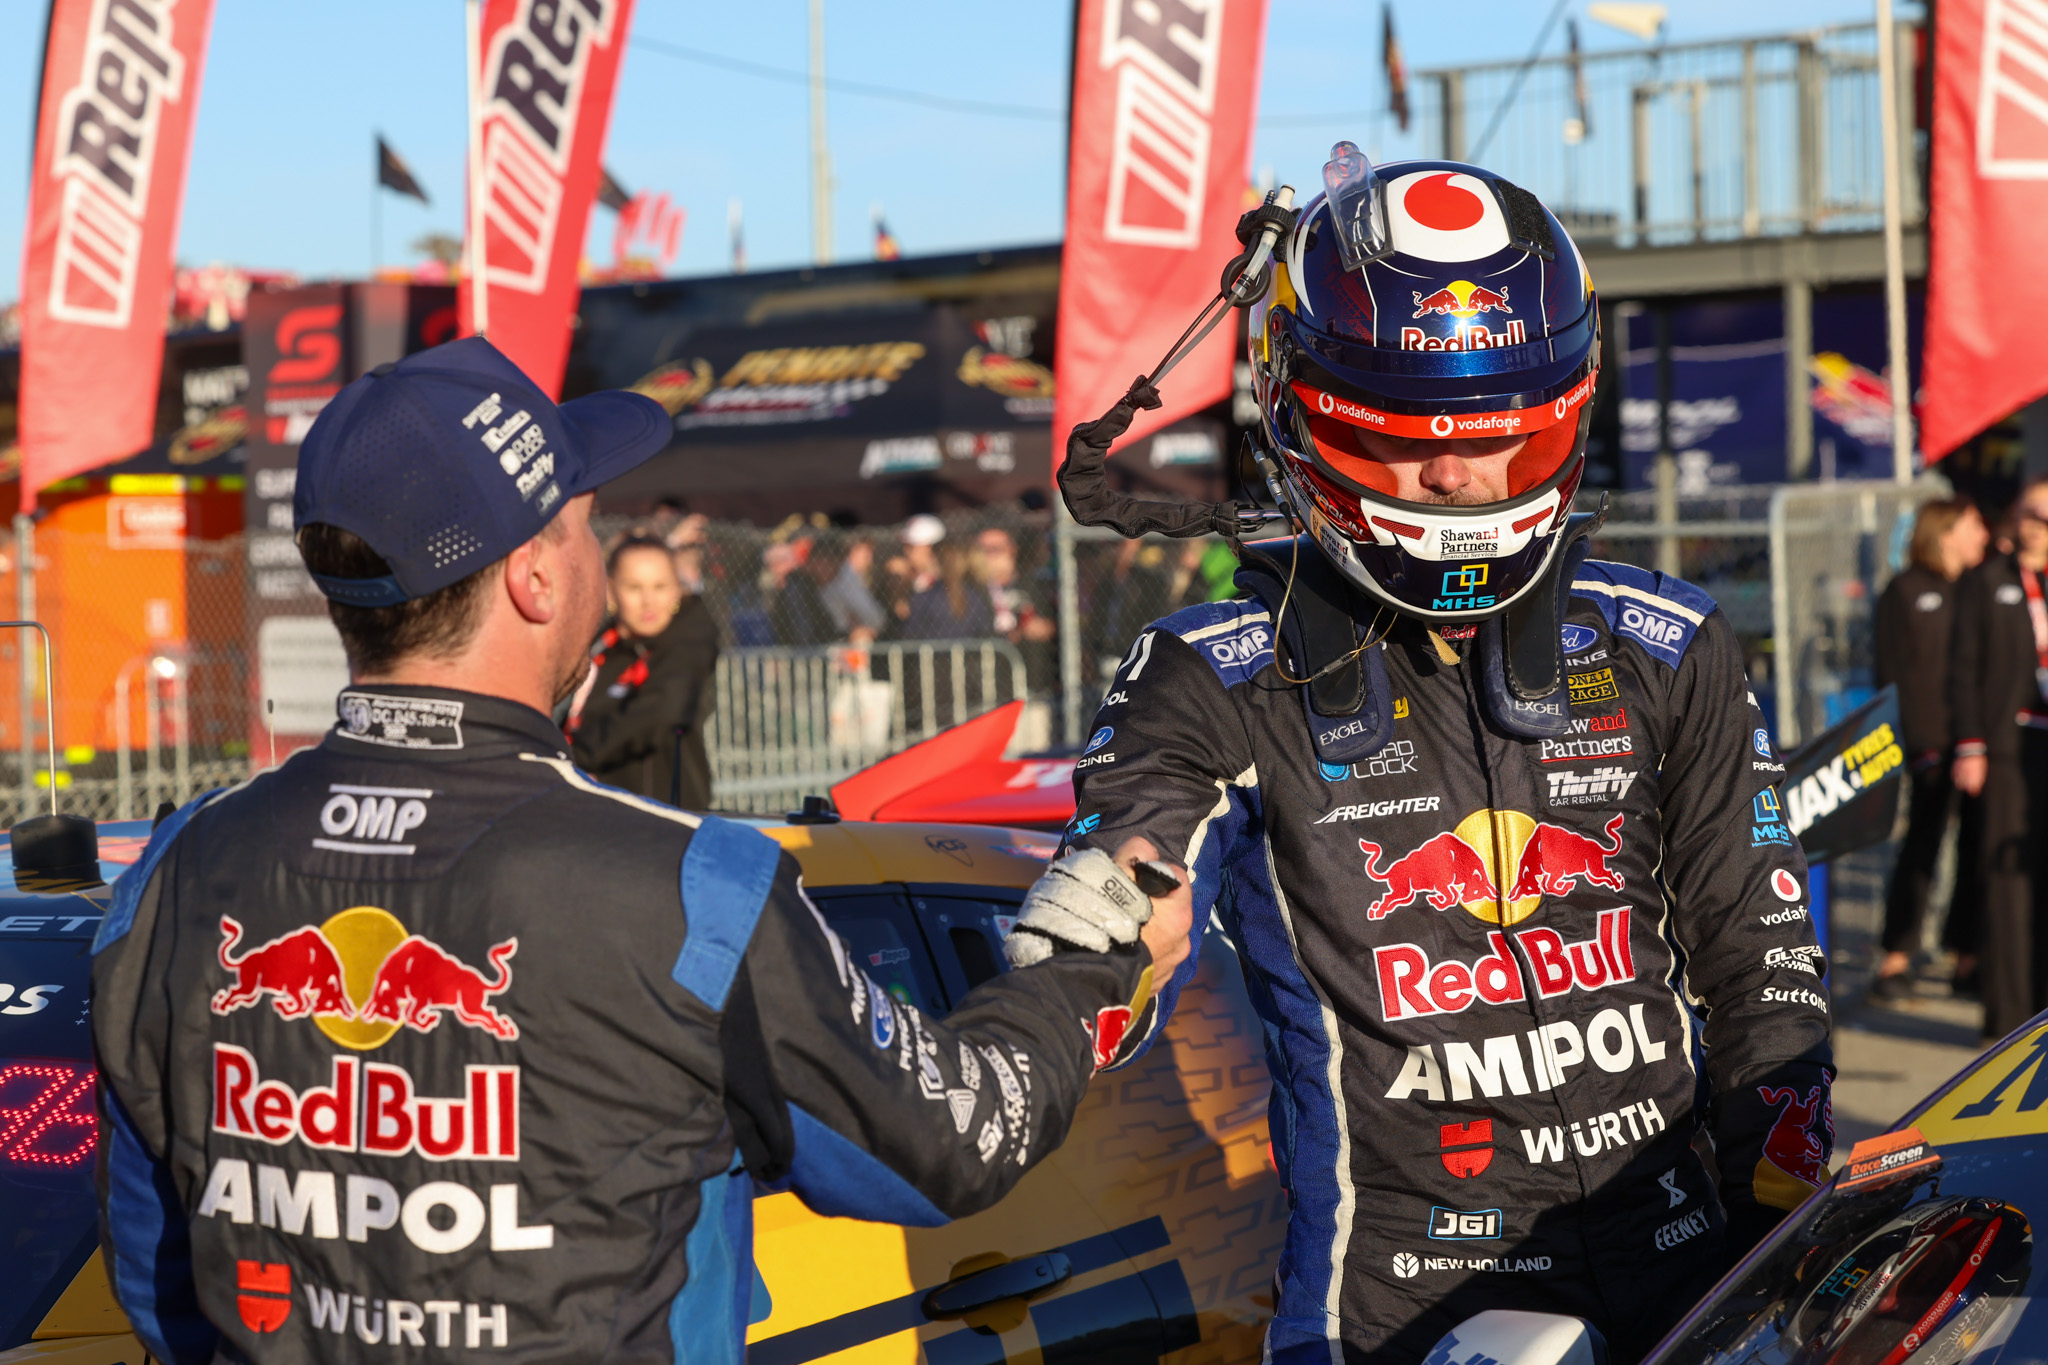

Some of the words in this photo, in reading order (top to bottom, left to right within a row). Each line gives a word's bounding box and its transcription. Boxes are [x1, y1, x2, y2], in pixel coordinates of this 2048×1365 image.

[1401, 324, 1466, 351] Red
[1468, 319, 1526, 349] Bull
[1336, 402, 1385, 425] vodafone
[1457, 416, 1521, 431] vodafone
[1440, 552, 1469, 560] Financial
[1441, 542, 1498, 553] Partners
[1432, 595, 1495, 609] MHS
[1623, 608, 1683, 645] OMP
[1212, 629, 1269, 663] OMP
[1565, 650, 1608, 667] ING
[1569, 669, 1611, 688] ONAL
[1570, 685, 1612, 701] RAGE
[1515, 701, 1563, 715] EXGEL
[1319, 720, 1367, 746] EXGEL
[1538, 736, 1632, 760] Partners
[1843, 723, 1895, 770] TYRES
[1077, 753, 1115, 768] CING
[1353, 756, 1418, 780] LOCK
[1859, 743, 1903, 788] AUTO
[1547, 767, 1638, 800] Thrifty
[1786, 755, 1856, 838] JAX
[1332, 796, 1440, 821] FREIGHTER
[1550, 798, 1569, 807] CAR
[1572, 796, 1608, 804] RENTAL
[320, 794, 427, 842] OMP
[1752, 824, 1790, 841] MHS
[1372, 931, 1527, 1021] Red
[1514, 906, 1636, 999] Bull
[1761, 987, 1827, 1014] Suttons
[1384, 1003, 1666, 1101] AMPOL
[213, 1042, 359, 1153] Red
[360, 1061, 520, 1161] Bull
[1520, 1098, 1667, 1164] WÜRTH
[1851, 1146, 1924, 1176] RaceScreen
[198, 1157, 553, 1253] AMPOL
[1435, 1212, 1495, 1236] JGI
[1655, 1204, 1710, 1252] FEENEY
[1424, 1258, 1464, 1270] NEW
[1467, 1256, 1552, 1272] HOLLAND
[303, 1284, 508, 1348] WÜRTH
